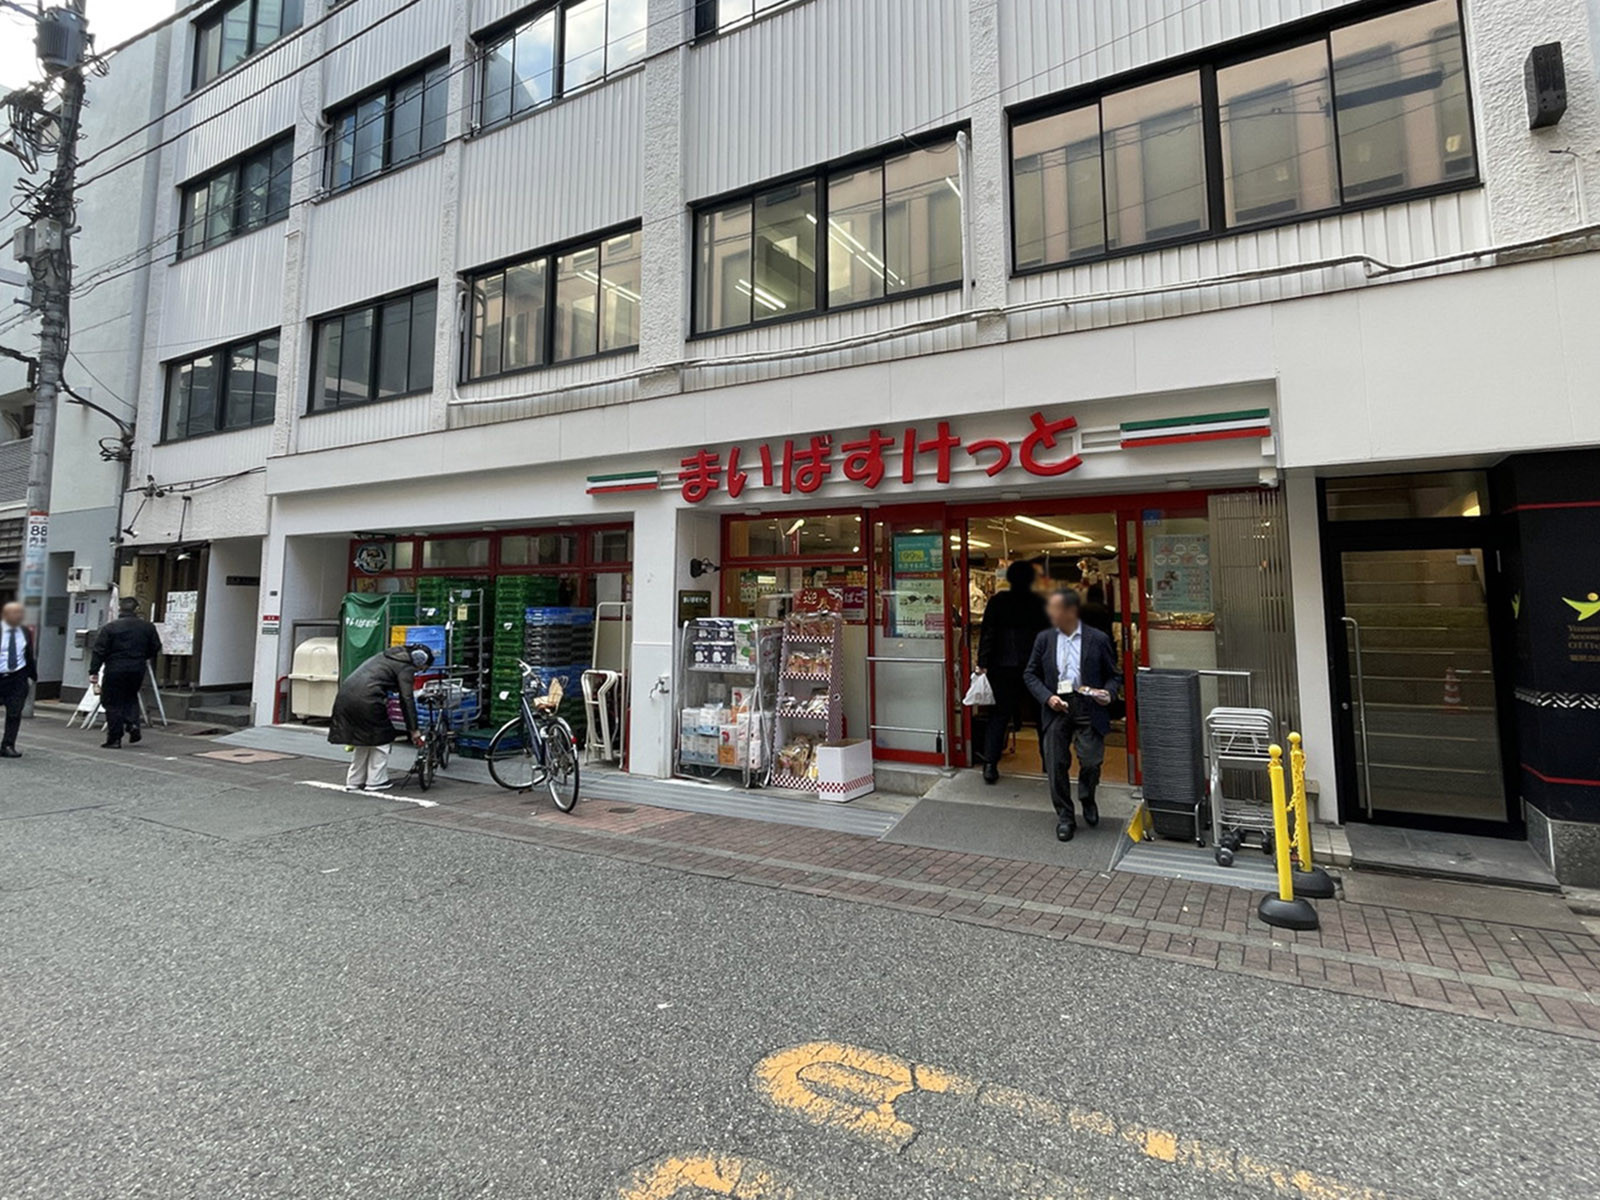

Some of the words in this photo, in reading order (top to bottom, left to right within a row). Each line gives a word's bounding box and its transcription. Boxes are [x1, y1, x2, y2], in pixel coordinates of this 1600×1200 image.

[678, 411, 1083, 504] まいばすけっと
[30, 525, 48, 536] 88
